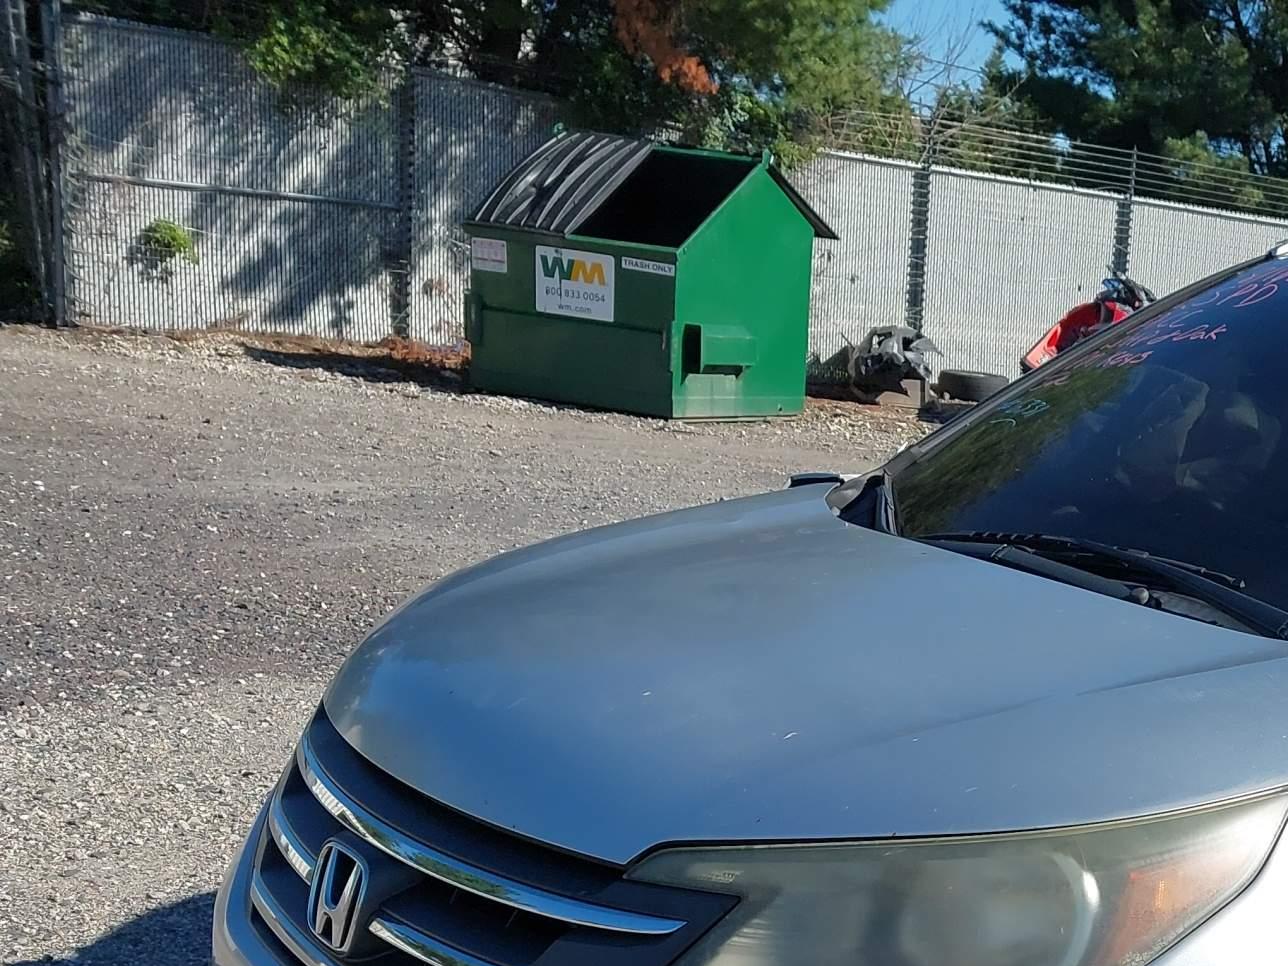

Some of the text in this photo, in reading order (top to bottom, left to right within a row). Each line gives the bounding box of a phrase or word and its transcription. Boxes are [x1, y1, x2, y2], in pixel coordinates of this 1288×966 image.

[540, 254, 606, 287] WM
[624, 258, 673, 273] TRASH ONLY
[583, 291, 605, 302] 0054
